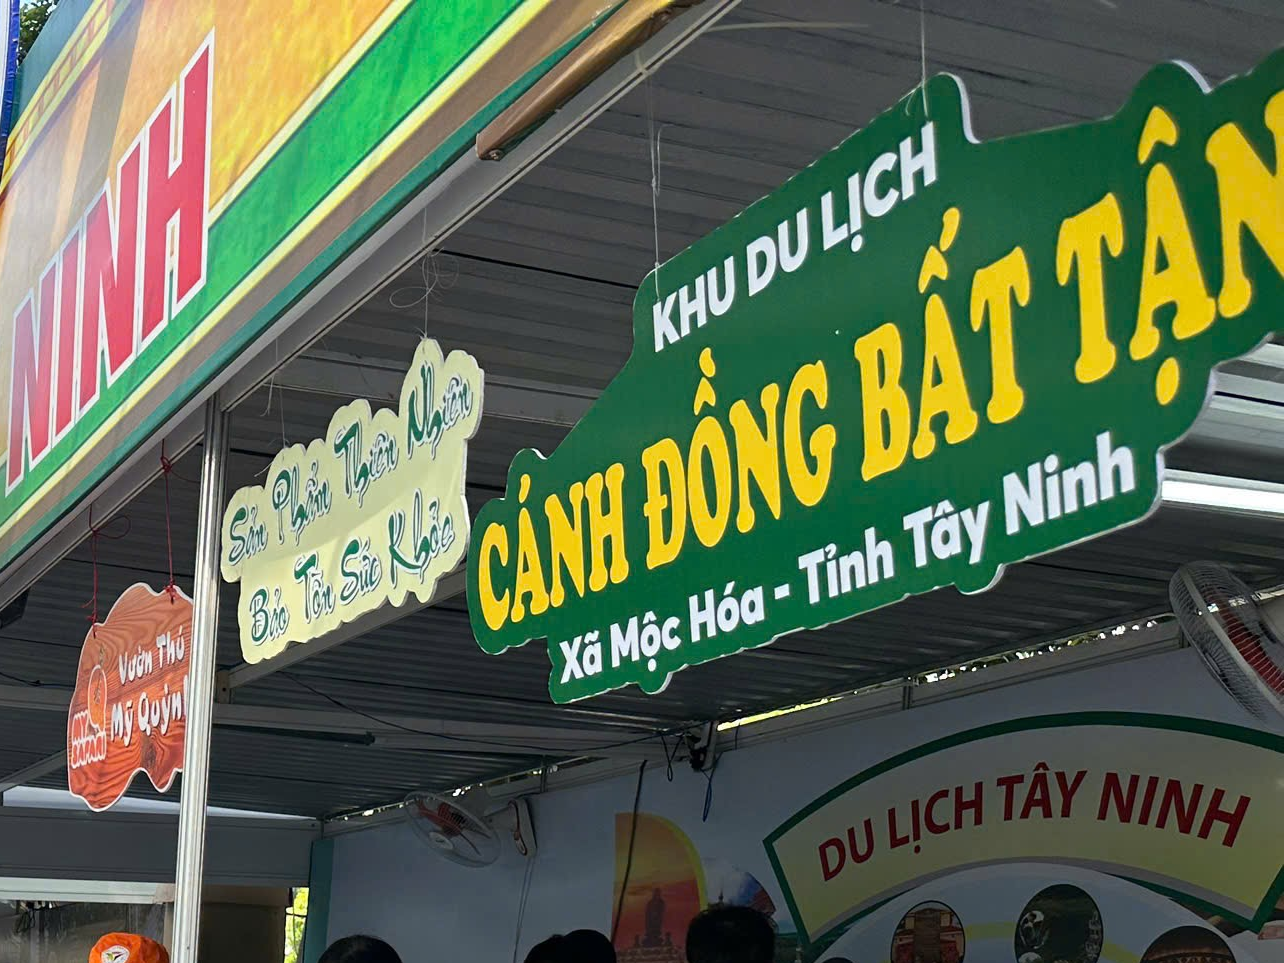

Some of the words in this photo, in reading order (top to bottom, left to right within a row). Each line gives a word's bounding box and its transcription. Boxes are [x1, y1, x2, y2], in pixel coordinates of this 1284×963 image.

[5, 29, 215, 496] NINH
[652, 256, 736, 353] KHU
[746, 207, 809, 297] DU
[821, 121, 937, 253] LỊCH
[229, 505, 269, 565] Sản
[272, 458, 332, 546] Phẩm
[334, 420, 400, 508] Thiên
[407, 360, 474, 460] Nhiên
[477, 463, 630, 633] CÁNH
[642, 346, 834, 564] ĐỒNG
[852, 207, 1031, 483] BẤT
[1056, 88, 1284, 406] TẬN
[118, 646, 153, 686] Vườn
[156, 625, 185, 669] Thú
[340, 536, 383, 605] Sức
[558, 629, 602, 684] Xã
[611, 609, 682, 672] Mộc
[690, 582, 766, 643] Hóa
[797, 525, 896, 606] Tỉnh
[902, 494, 991, 569] Tây
[1000, 428, 1136, 536] Ninh
[110, 701, 134, 747] Mỹ
[818, 817, 874, 882] DU
[886, 780, 984, 853] LỊCH
[996, 761, 1087, 821] TÂY
[1097, 771, 1251, 848] NINH
